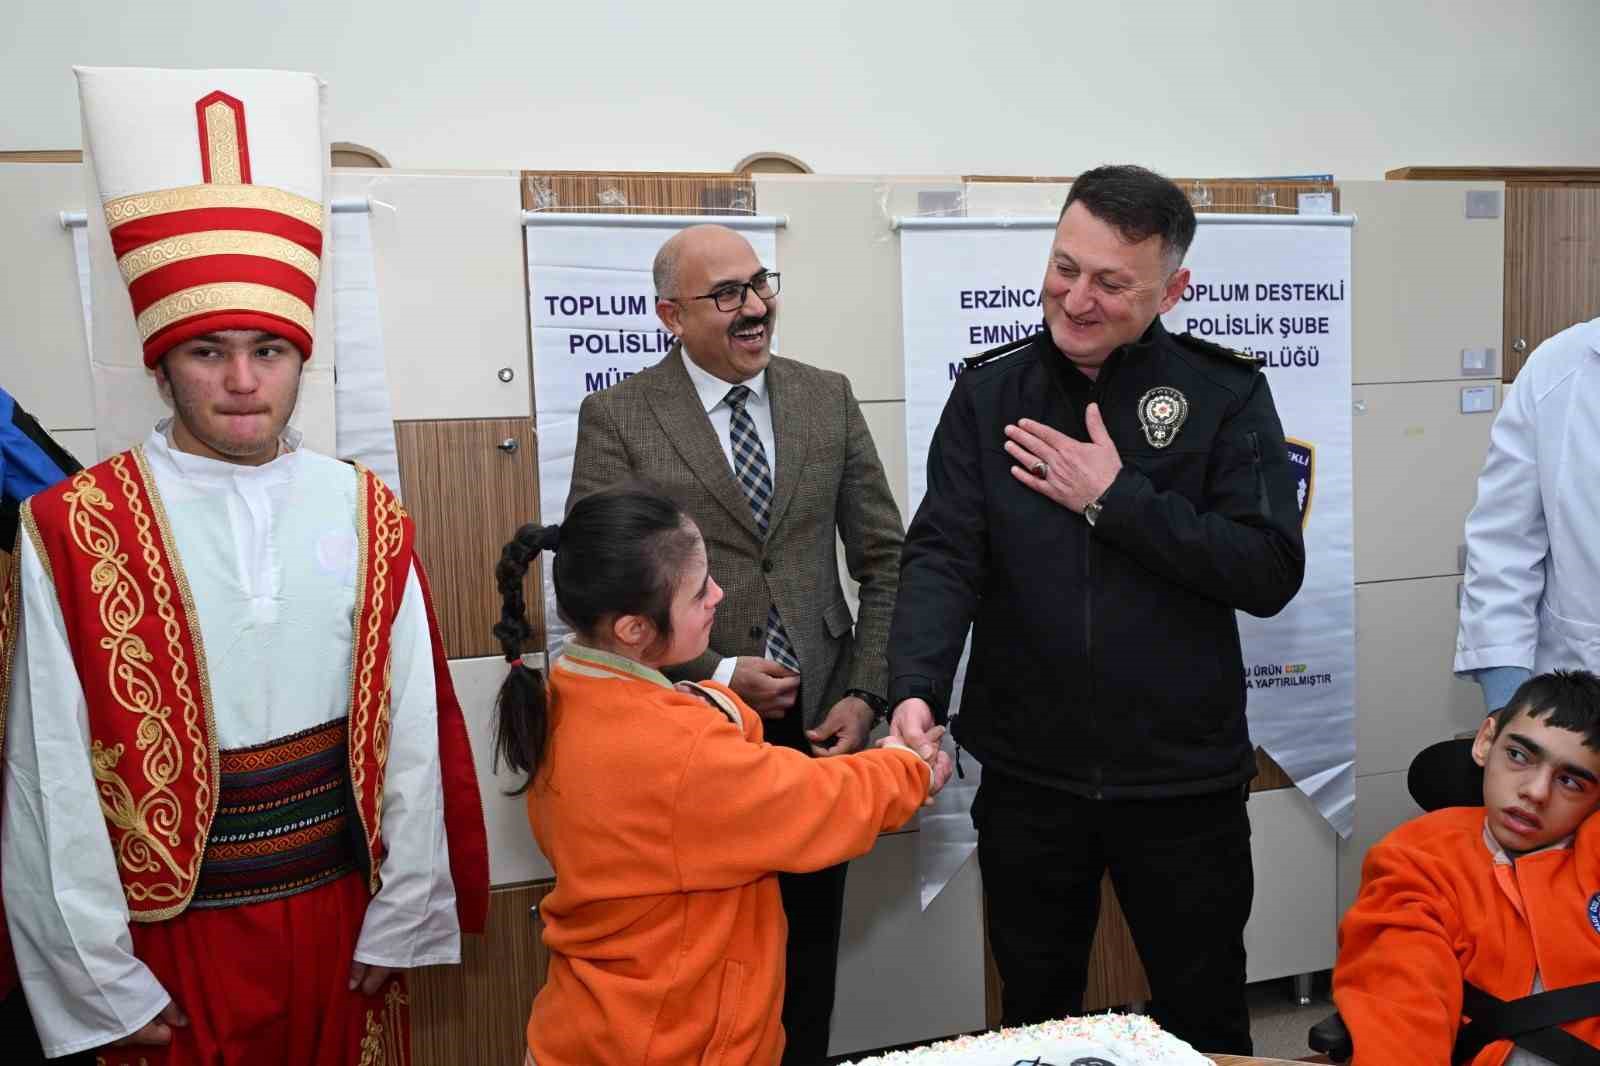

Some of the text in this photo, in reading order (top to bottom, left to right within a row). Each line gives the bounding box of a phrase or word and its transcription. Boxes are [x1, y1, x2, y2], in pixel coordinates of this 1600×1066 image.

[1182, 280, 1344, 301] OPLUM DESTEKLİ
[544, 295, 647, 316] TOPLUM
[1186, 314, 1329, 339] POLİSLİK ŞUBE
[569, 328, 676, 354] POLİSLİK
[1254, 663, 1282, 677] ÜRÜN
